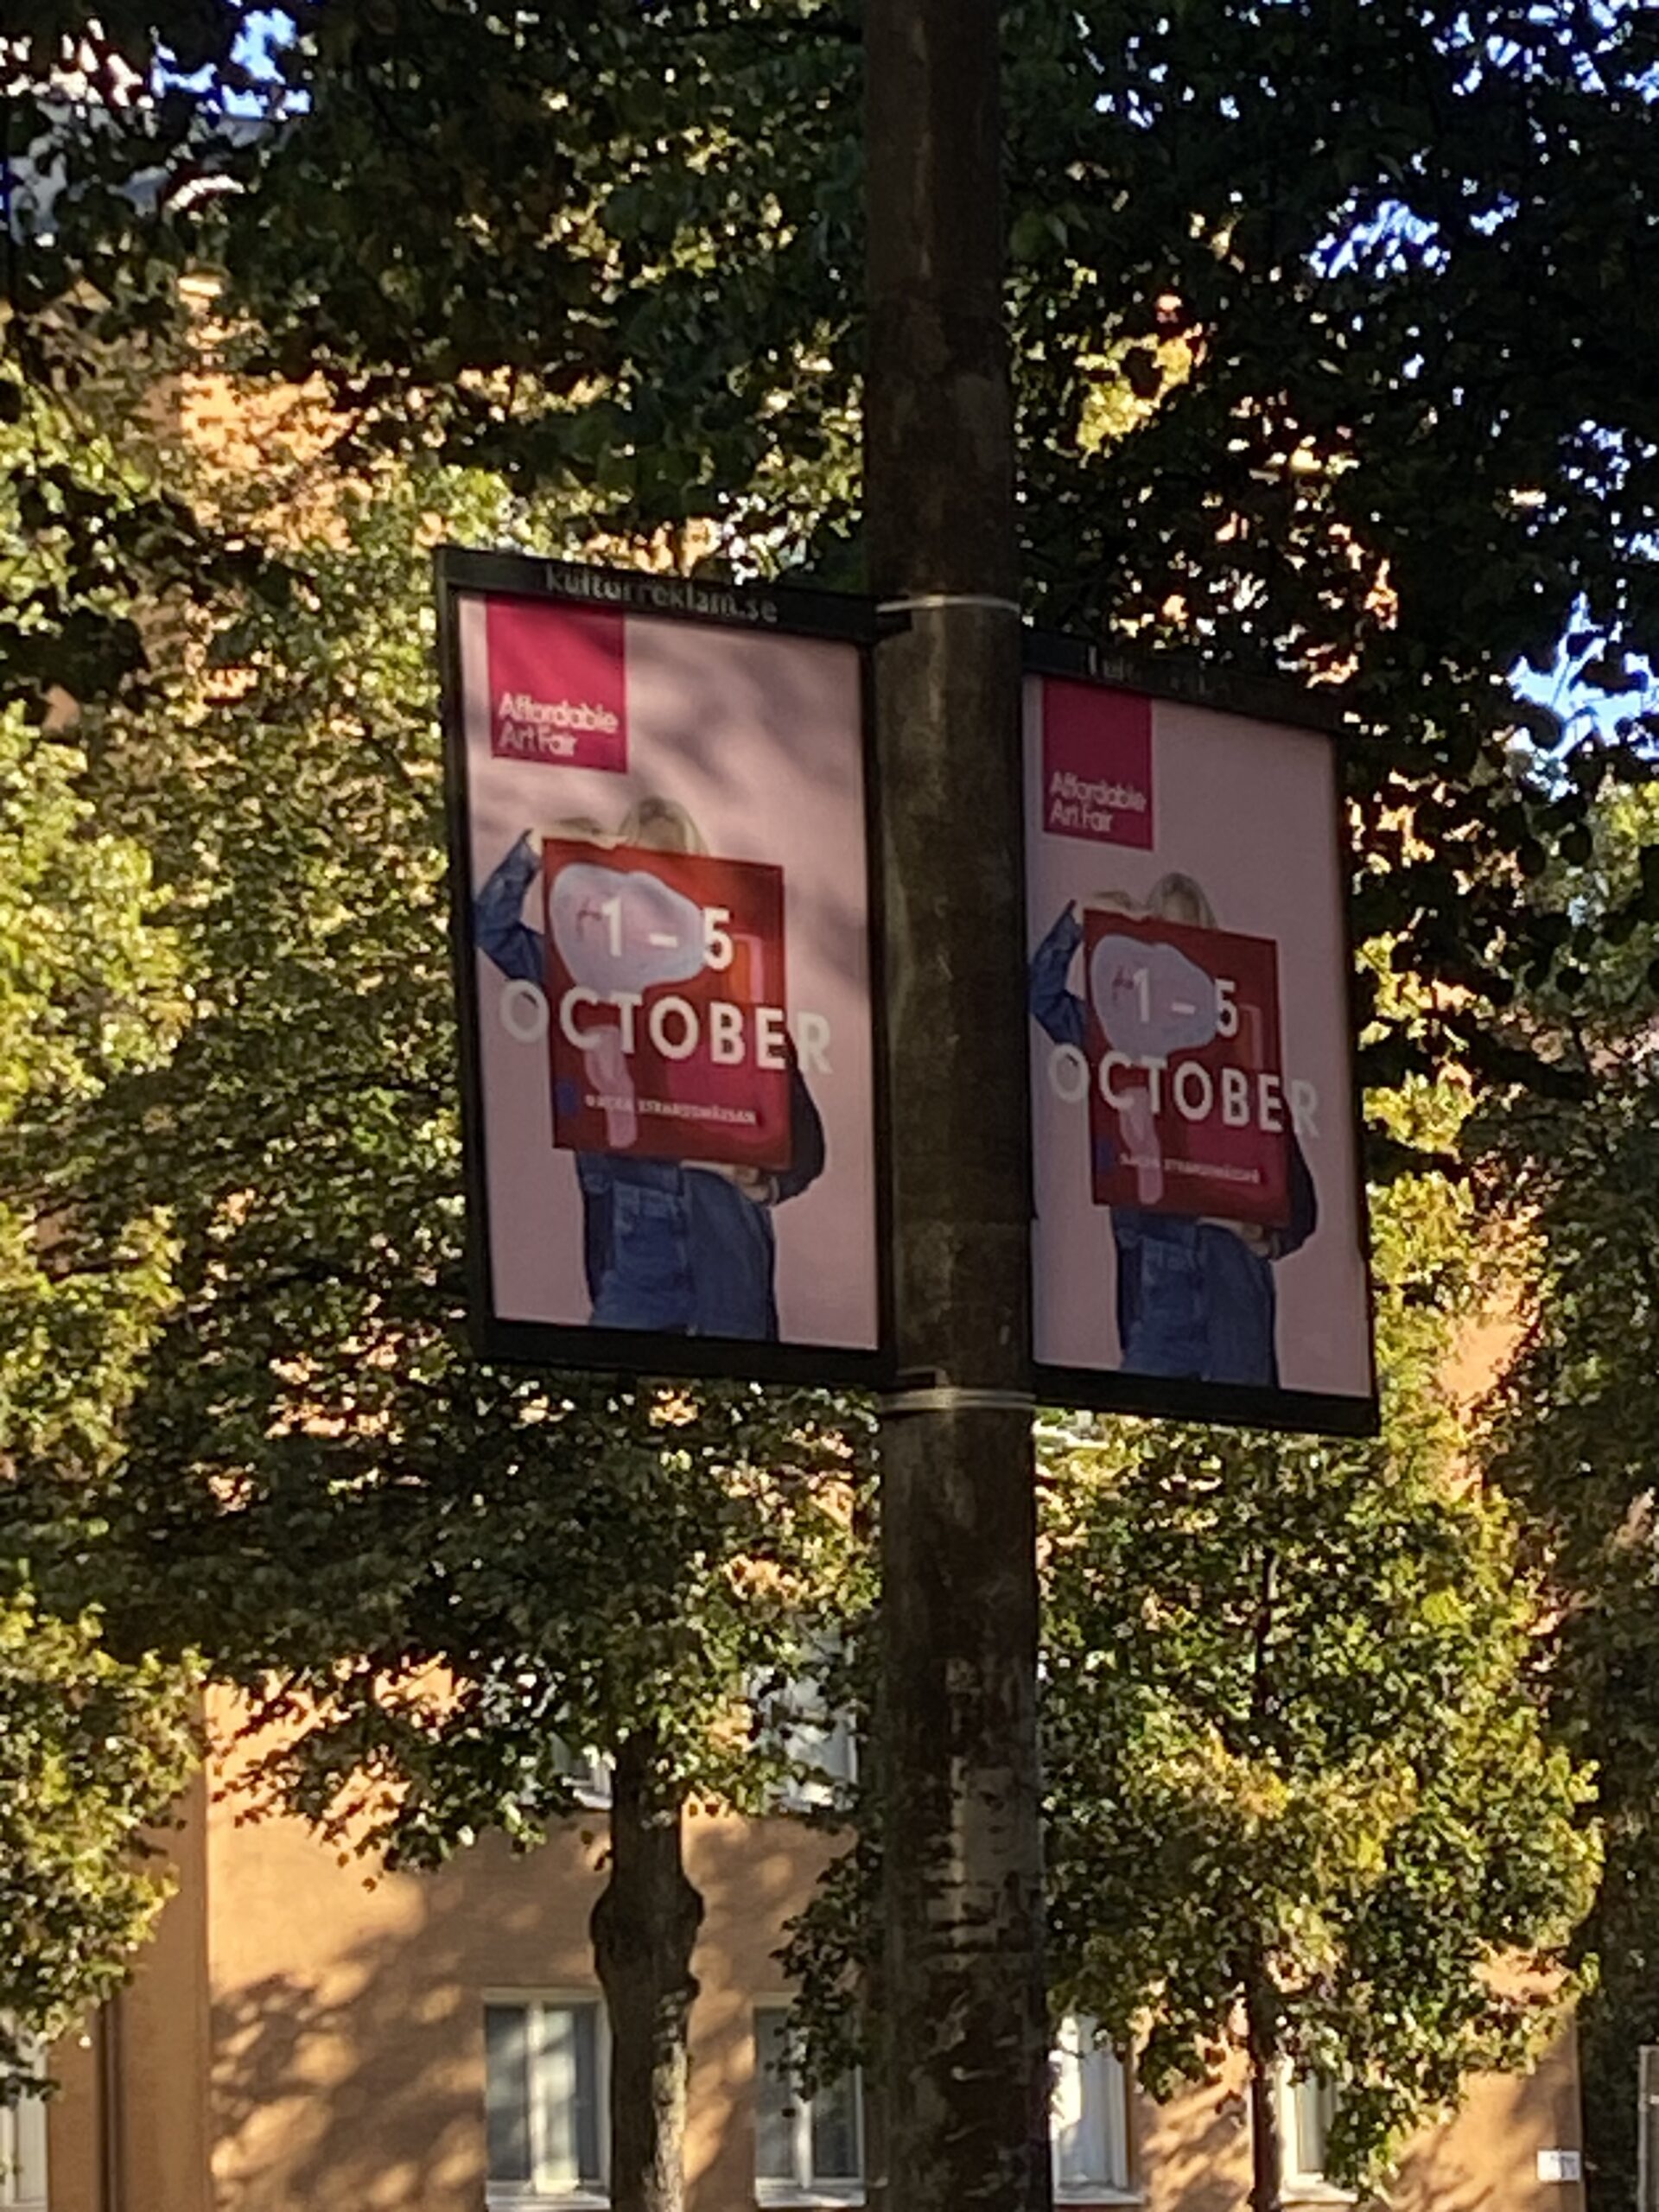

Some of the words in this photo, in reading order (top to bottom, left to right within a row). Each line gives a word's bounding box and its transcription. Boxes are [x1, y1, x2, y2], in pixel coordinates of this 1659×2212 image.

[499, 691, 619, 734] Affordable
[499, 721, 535, 753] Art
[537, 724, 578, 757] Fair
[1049, 771, 1147, 812] Affordable
[601, 896, 622, 957] 1
[703, 906, 734, 970] 5
[500, 979, 833, 1075] OCTOBER
[1132, 967, 1151, 1022] 1
[1214, 977, 1238, 1037] 5
[1047, 1043, 1320, 1139] OCTOBER
